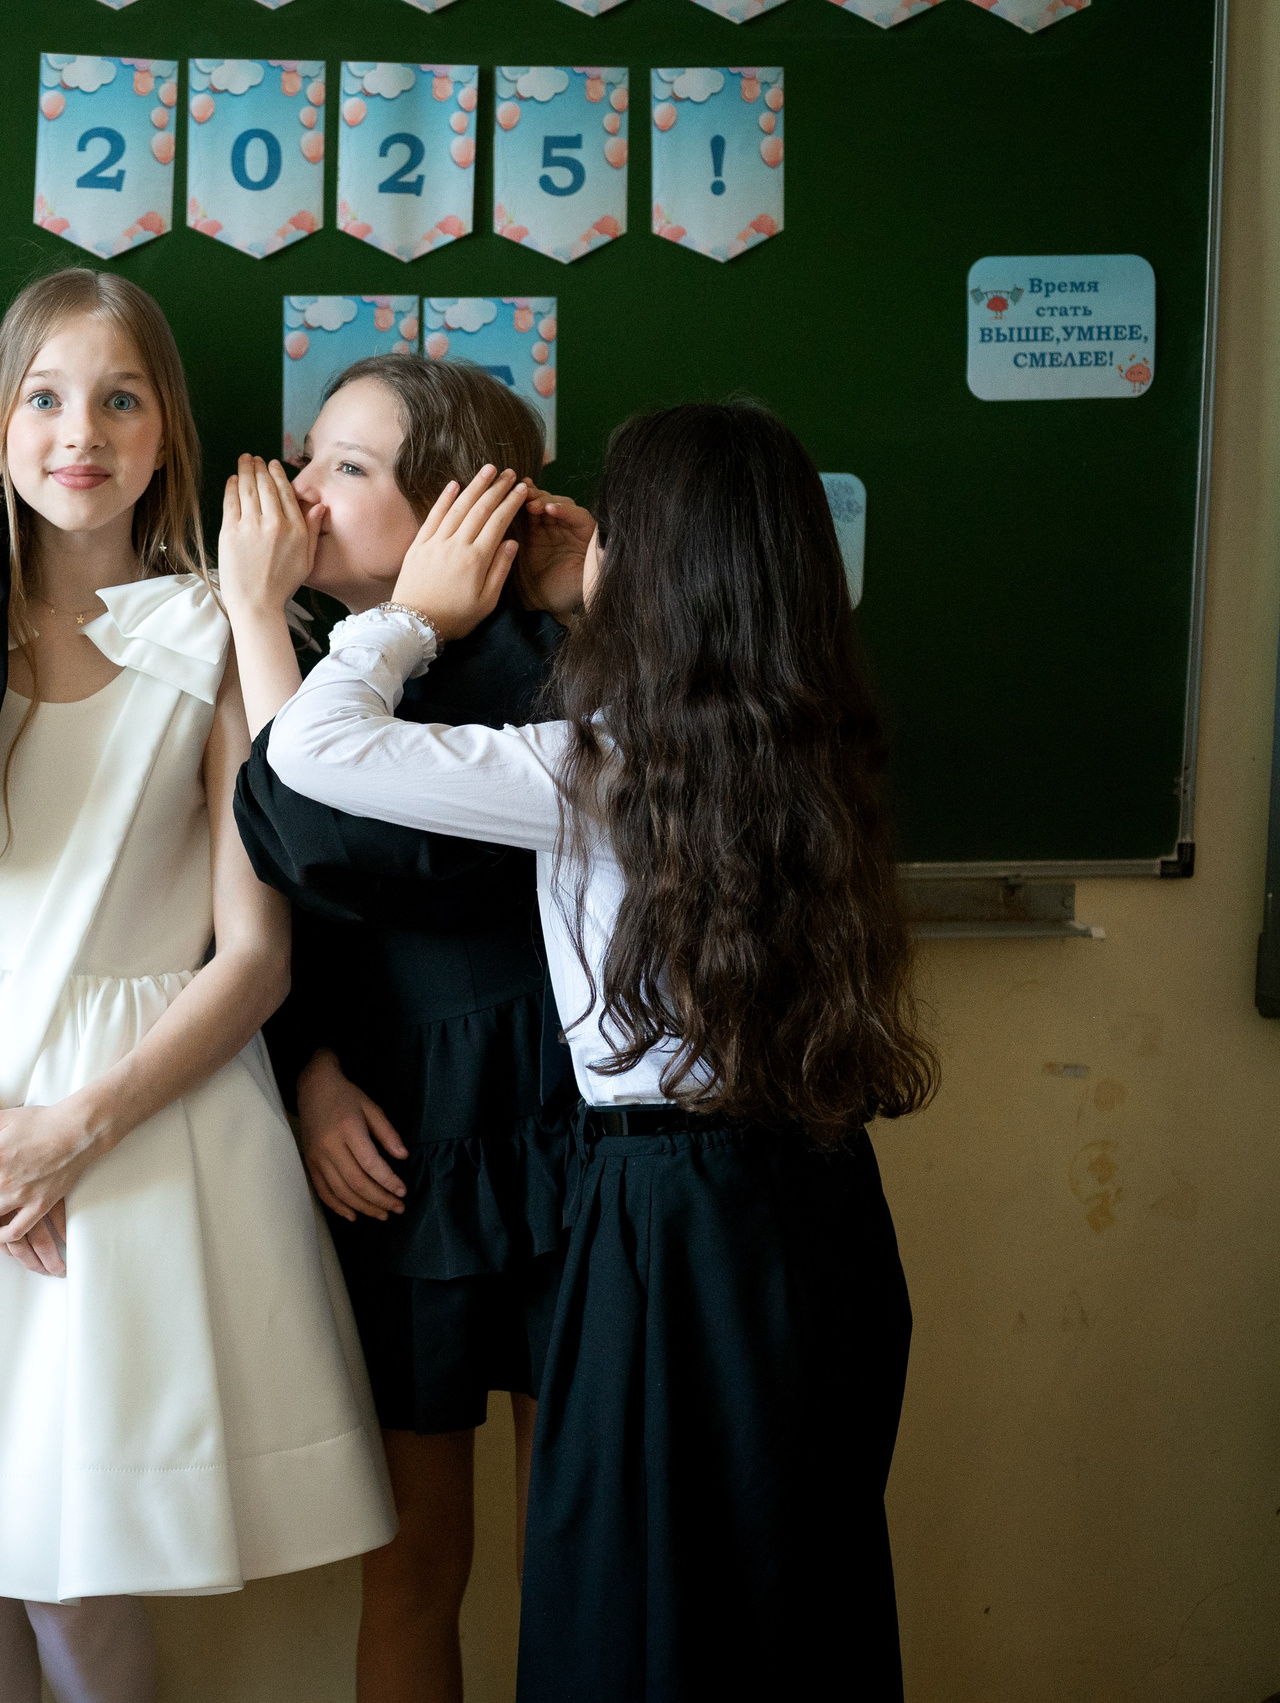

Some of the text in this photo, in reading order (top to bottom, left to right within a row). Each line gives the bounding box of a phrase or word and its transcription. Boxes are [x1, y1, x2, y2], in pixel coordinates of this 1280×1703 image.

[1029, 277, 1099, 297] Время
[1035, 306, 1093, 317] стать
[1013, 351, 1113, 368] СМЕЛЕЕ!
